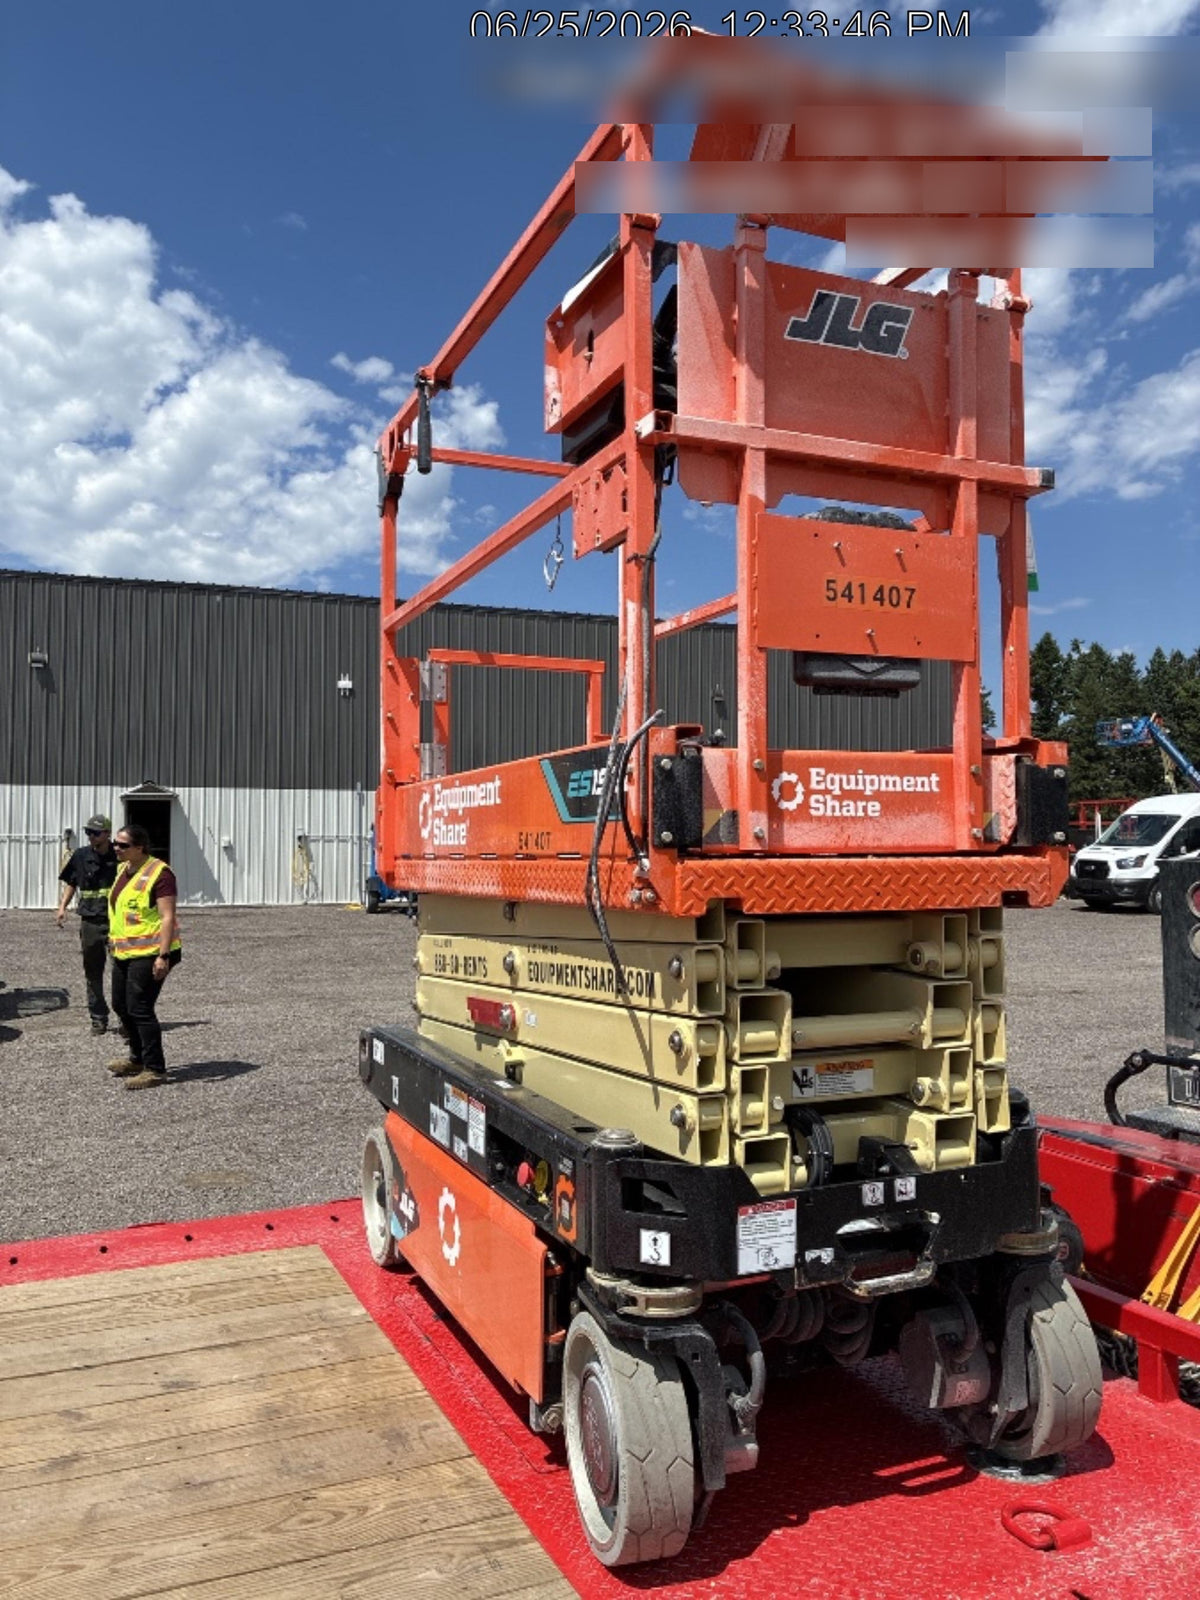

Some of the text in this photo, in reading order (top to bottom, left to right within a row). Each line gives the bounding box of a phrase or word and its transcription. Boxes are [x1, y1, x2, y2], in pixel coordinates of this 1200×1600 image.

[784, 288, 915, 358] JLG
[825, 578, 917, 609] 541407
[433, 774, 502, 815] Equipment
[808, 767, 940, 796] Equipment
[808, 794, 881, 817] Share
[432, 816, 467, 846] Share
[518, 831, 551, 851] 54407
